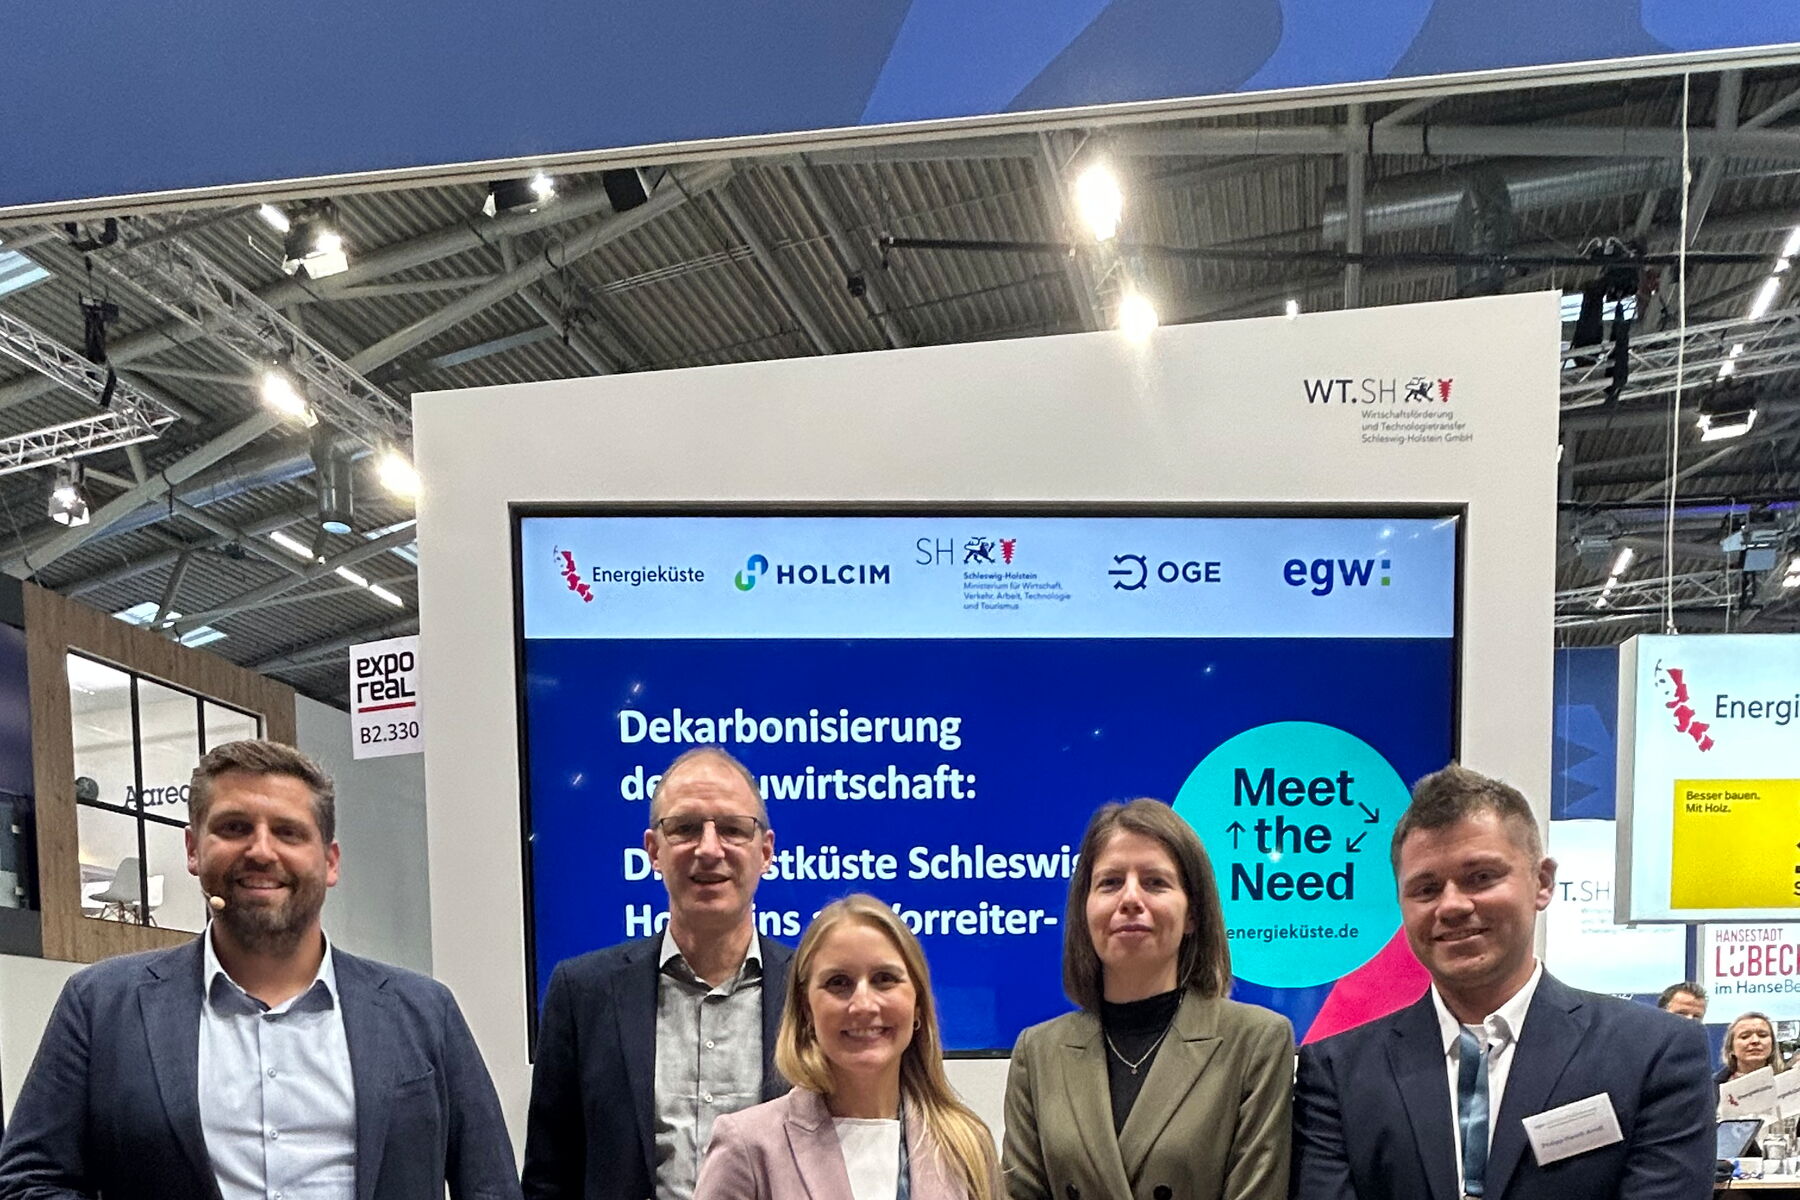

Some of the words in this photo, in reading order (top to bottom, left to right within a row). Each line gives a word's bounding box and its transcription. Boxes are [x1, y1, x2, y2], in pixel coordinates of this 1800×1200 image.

[1361, 410, 1453, 420] Wirtschaftsförderung
[1361, 422, 1378, 431] und
[1380, 422, 1466, 432] Technologietransfer
[1361, 433, 1442, 444] Schleswig-Holstein
[1444, 433, 1473, 442] GmbH
[915, 537, 954, 566] SH
[592, 565, 705, 587] Energieküste
[776, 564, 890, 585] HOLCIM
[963, 571, 1037, 581] Schleswig-Holstein
[1157, 561, 1221, 583] OGE
[963, 582, 1008, 590] Ministerium
[1009, 582, 1020, 590] für
[963, 602, 979, 610] und
[981, 602, 1019, 610] Tourismus
[1025, 592, 1071, 602] Technologie
[357, 651, 415, 684] expo
[1715, 693, 1800, 726] Energi
[361, 721, 419, 744] B2.330
[620, 708, 962, 751] Dekarbonisierung
[620, 766, 663, 801] de
[1233, 767, 1355, 807] Meet
[1686, 790, 1723, 801] Besser
[1724, 790, 1760, 801] bauen.
[1685, 803, 1703, 813] Mit
[1704, 803, 1732, 813] Holz.
[1254, 815, 1333, 854] the
[1231, 862, 1355, 901] Need
[1558, 880, 1610, 902] T.SH
[1715, 928, 1784, 943] HANSESTADT
[1715, 982, 1733, 995] im
